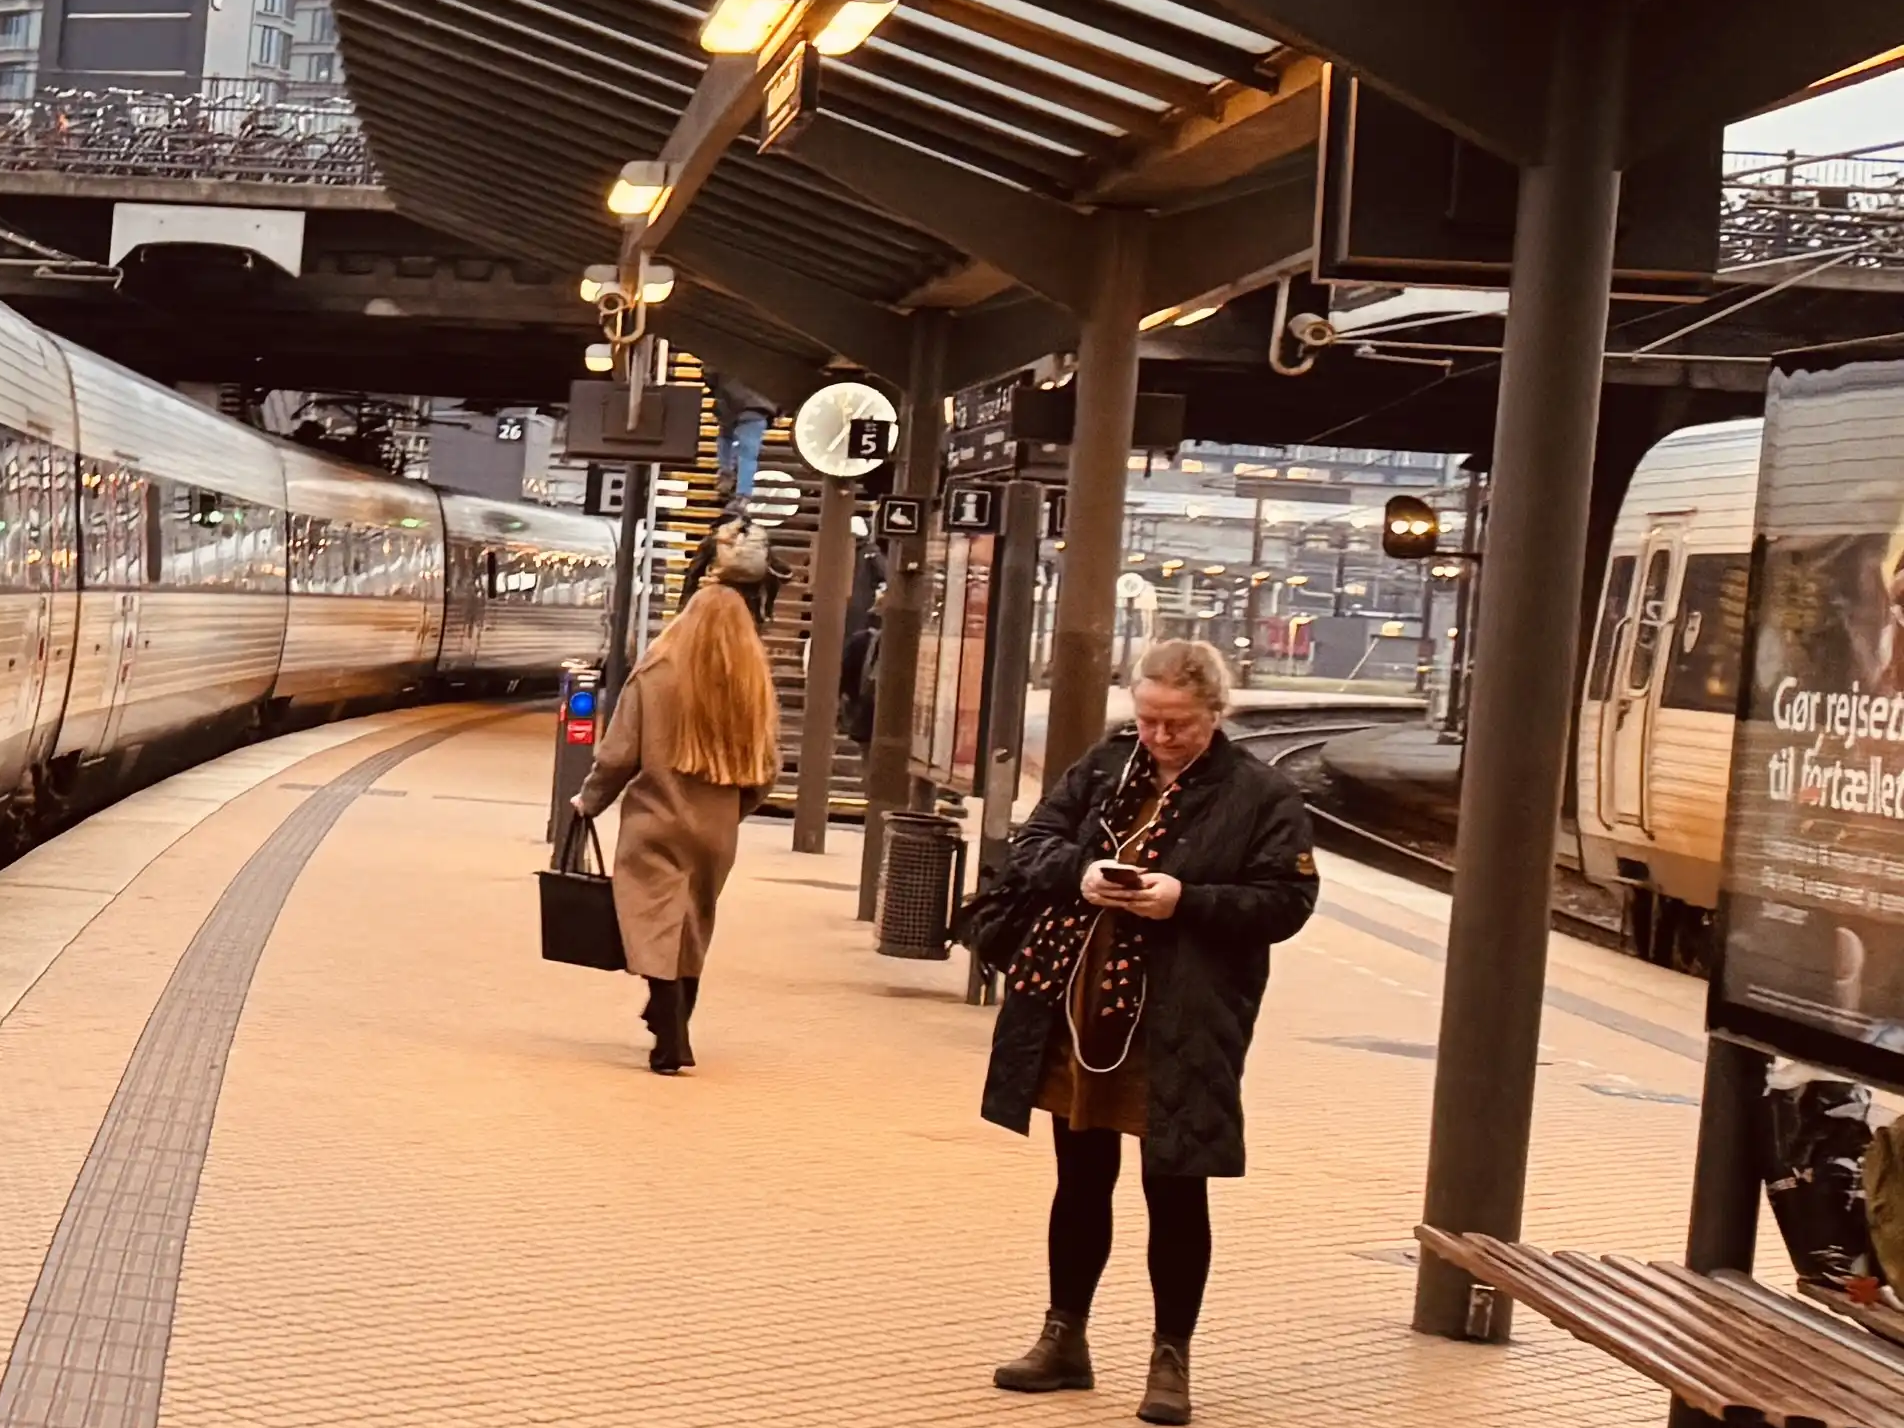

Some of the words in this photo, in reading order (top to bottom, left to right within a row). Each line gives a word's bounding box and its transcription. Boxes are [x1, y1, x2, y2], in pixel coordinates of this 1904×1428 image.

[498, 424, 522, 440] 26
[860, 433, 877, 454] 5
[599, 472, 627, 513] B
[1773, 676, 1822, 732] Gør
[1768, 746, 1795, 801] til
